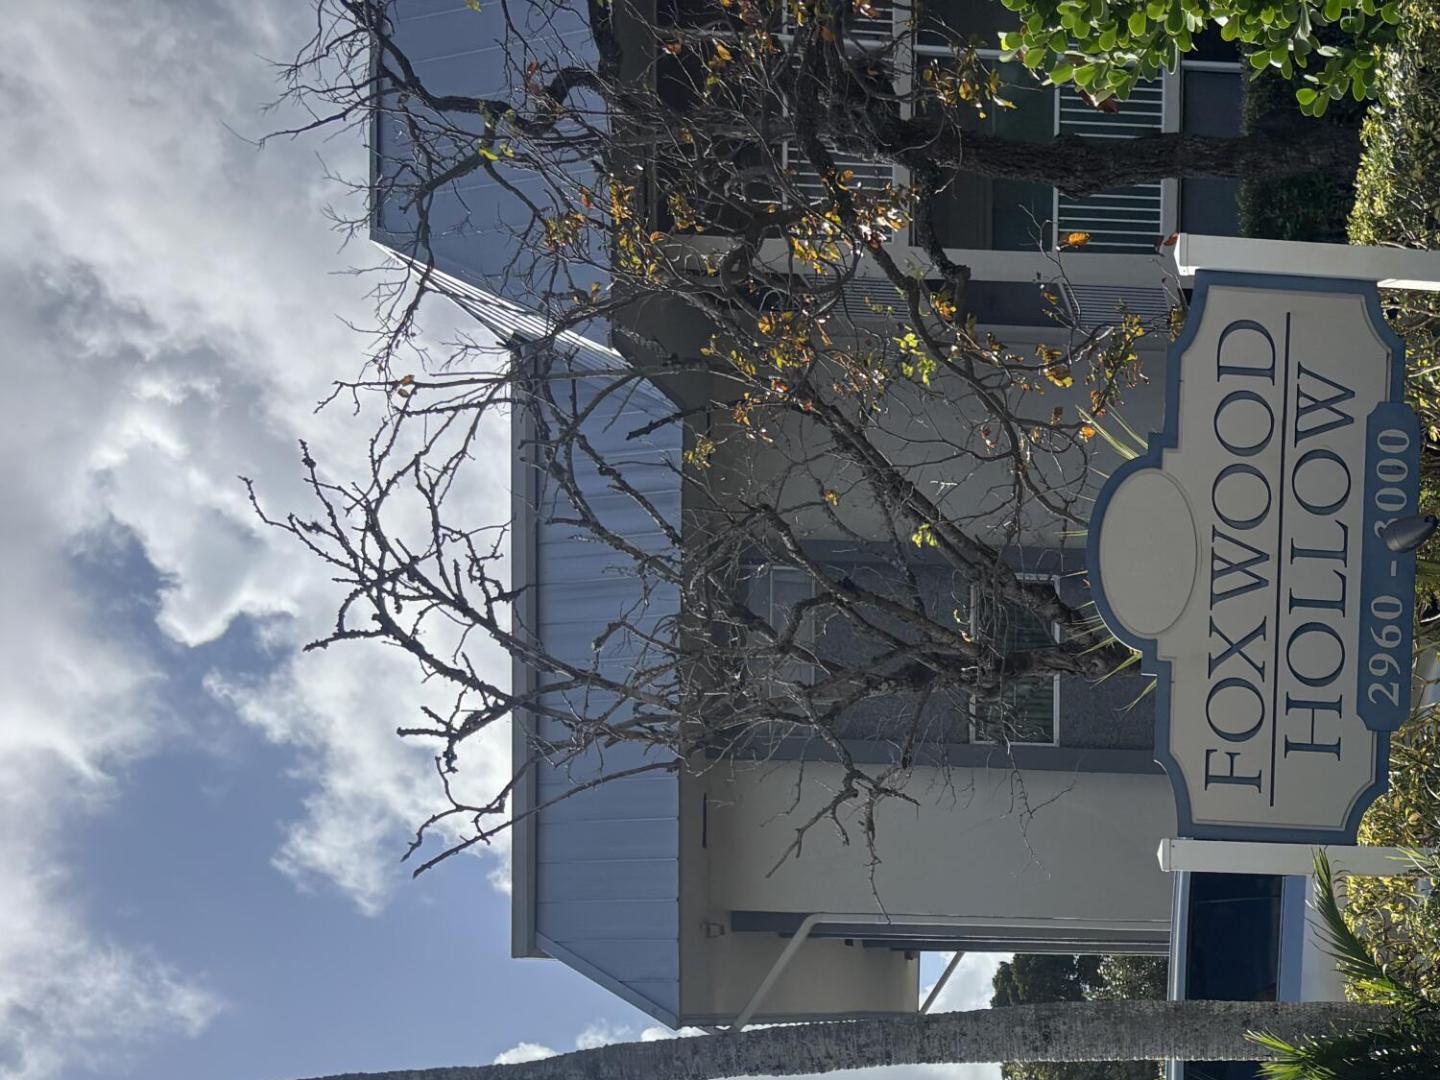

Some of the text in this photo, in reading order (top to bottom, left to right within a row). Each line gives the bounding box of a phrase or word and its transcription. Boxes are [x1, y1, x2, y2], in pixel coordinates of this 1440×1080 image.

[1204, 319, 1277, 793] FOXWOOD
[1284, 361, 1356, 761] HOLLOW
[1367, 594, 1404, 707] 2960
